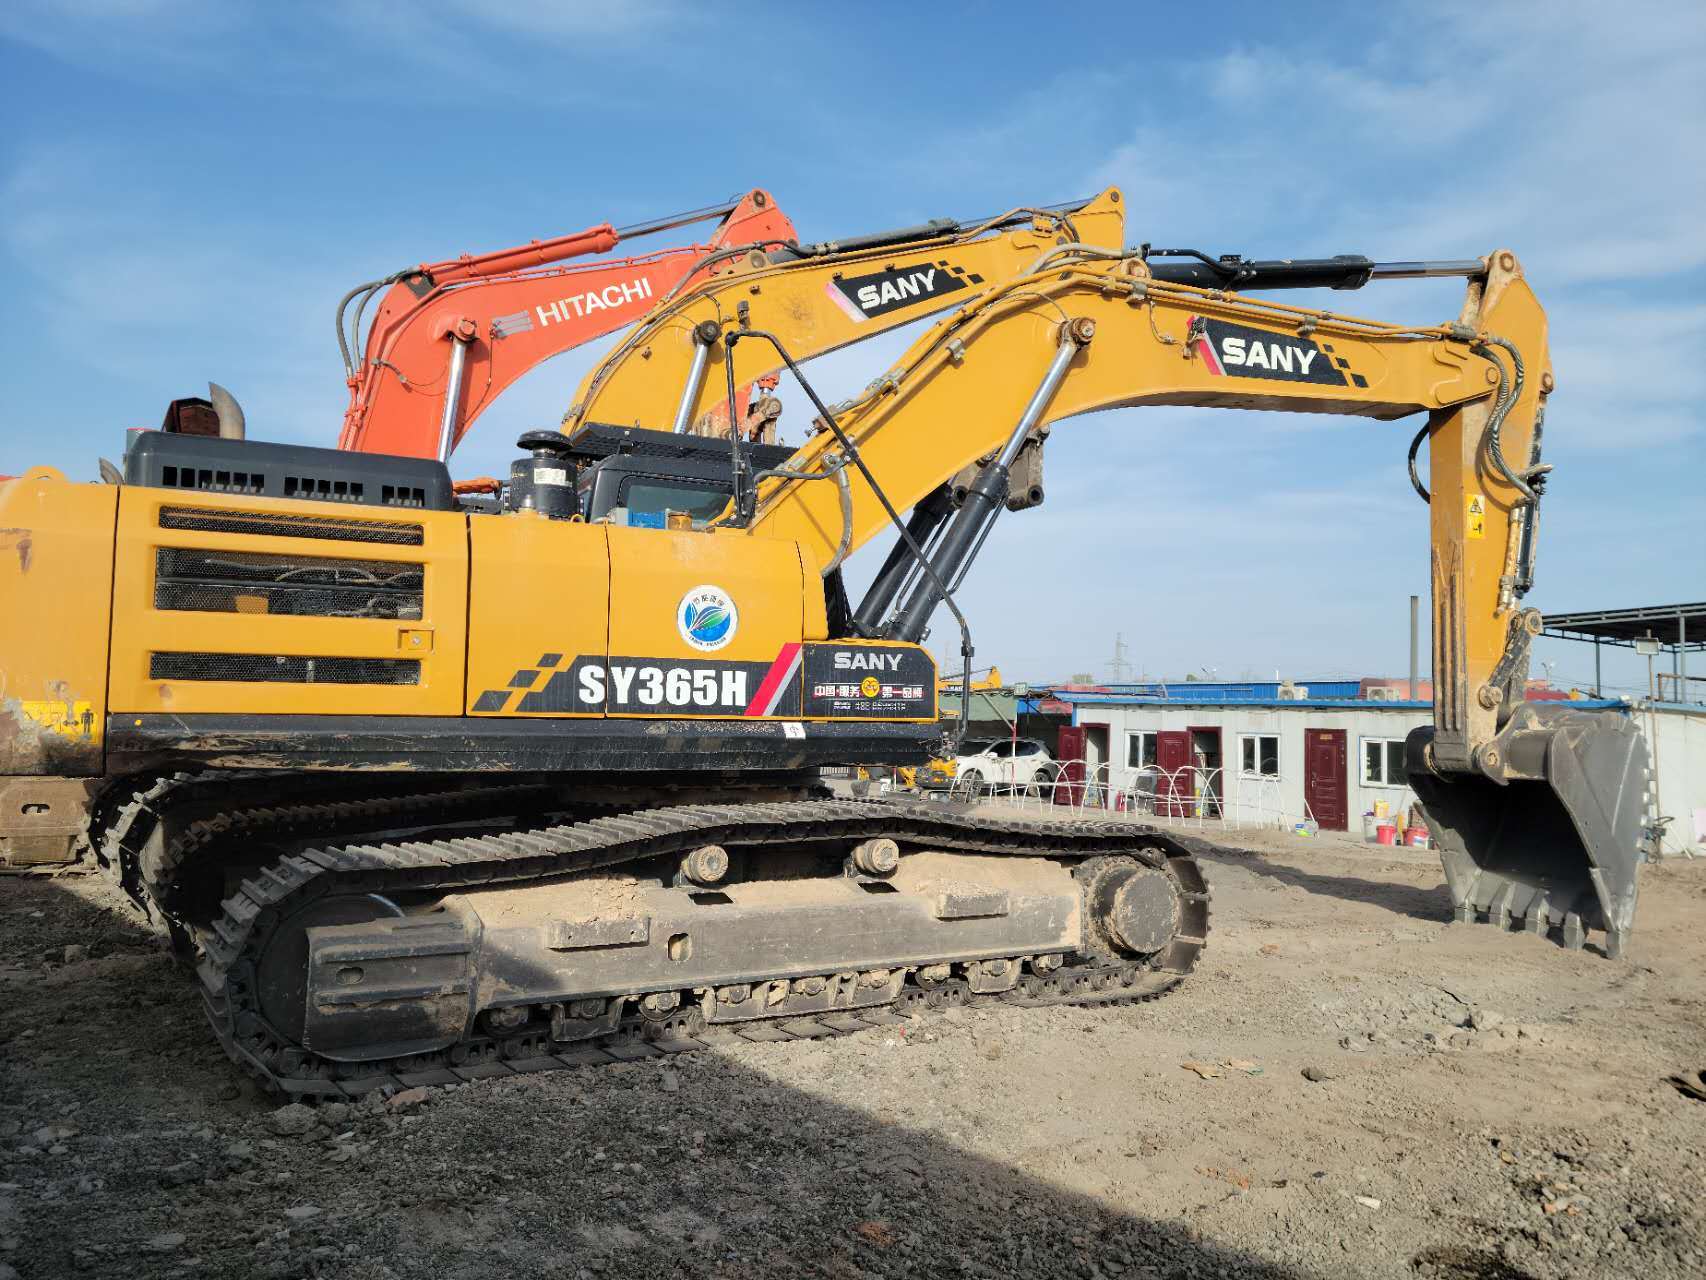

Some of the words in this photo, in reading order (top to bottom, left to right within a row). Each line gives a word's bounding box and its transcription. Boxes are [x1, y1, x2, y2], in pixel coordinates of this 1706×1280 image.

[536, 278, 652, 326] HITACHI
[857, 269, 935, 310] SANY
[1222, 337, 1317, 375] SANY
[834, 652, 903, 671] SANY
[578, 664, 747, 706] SY365H
